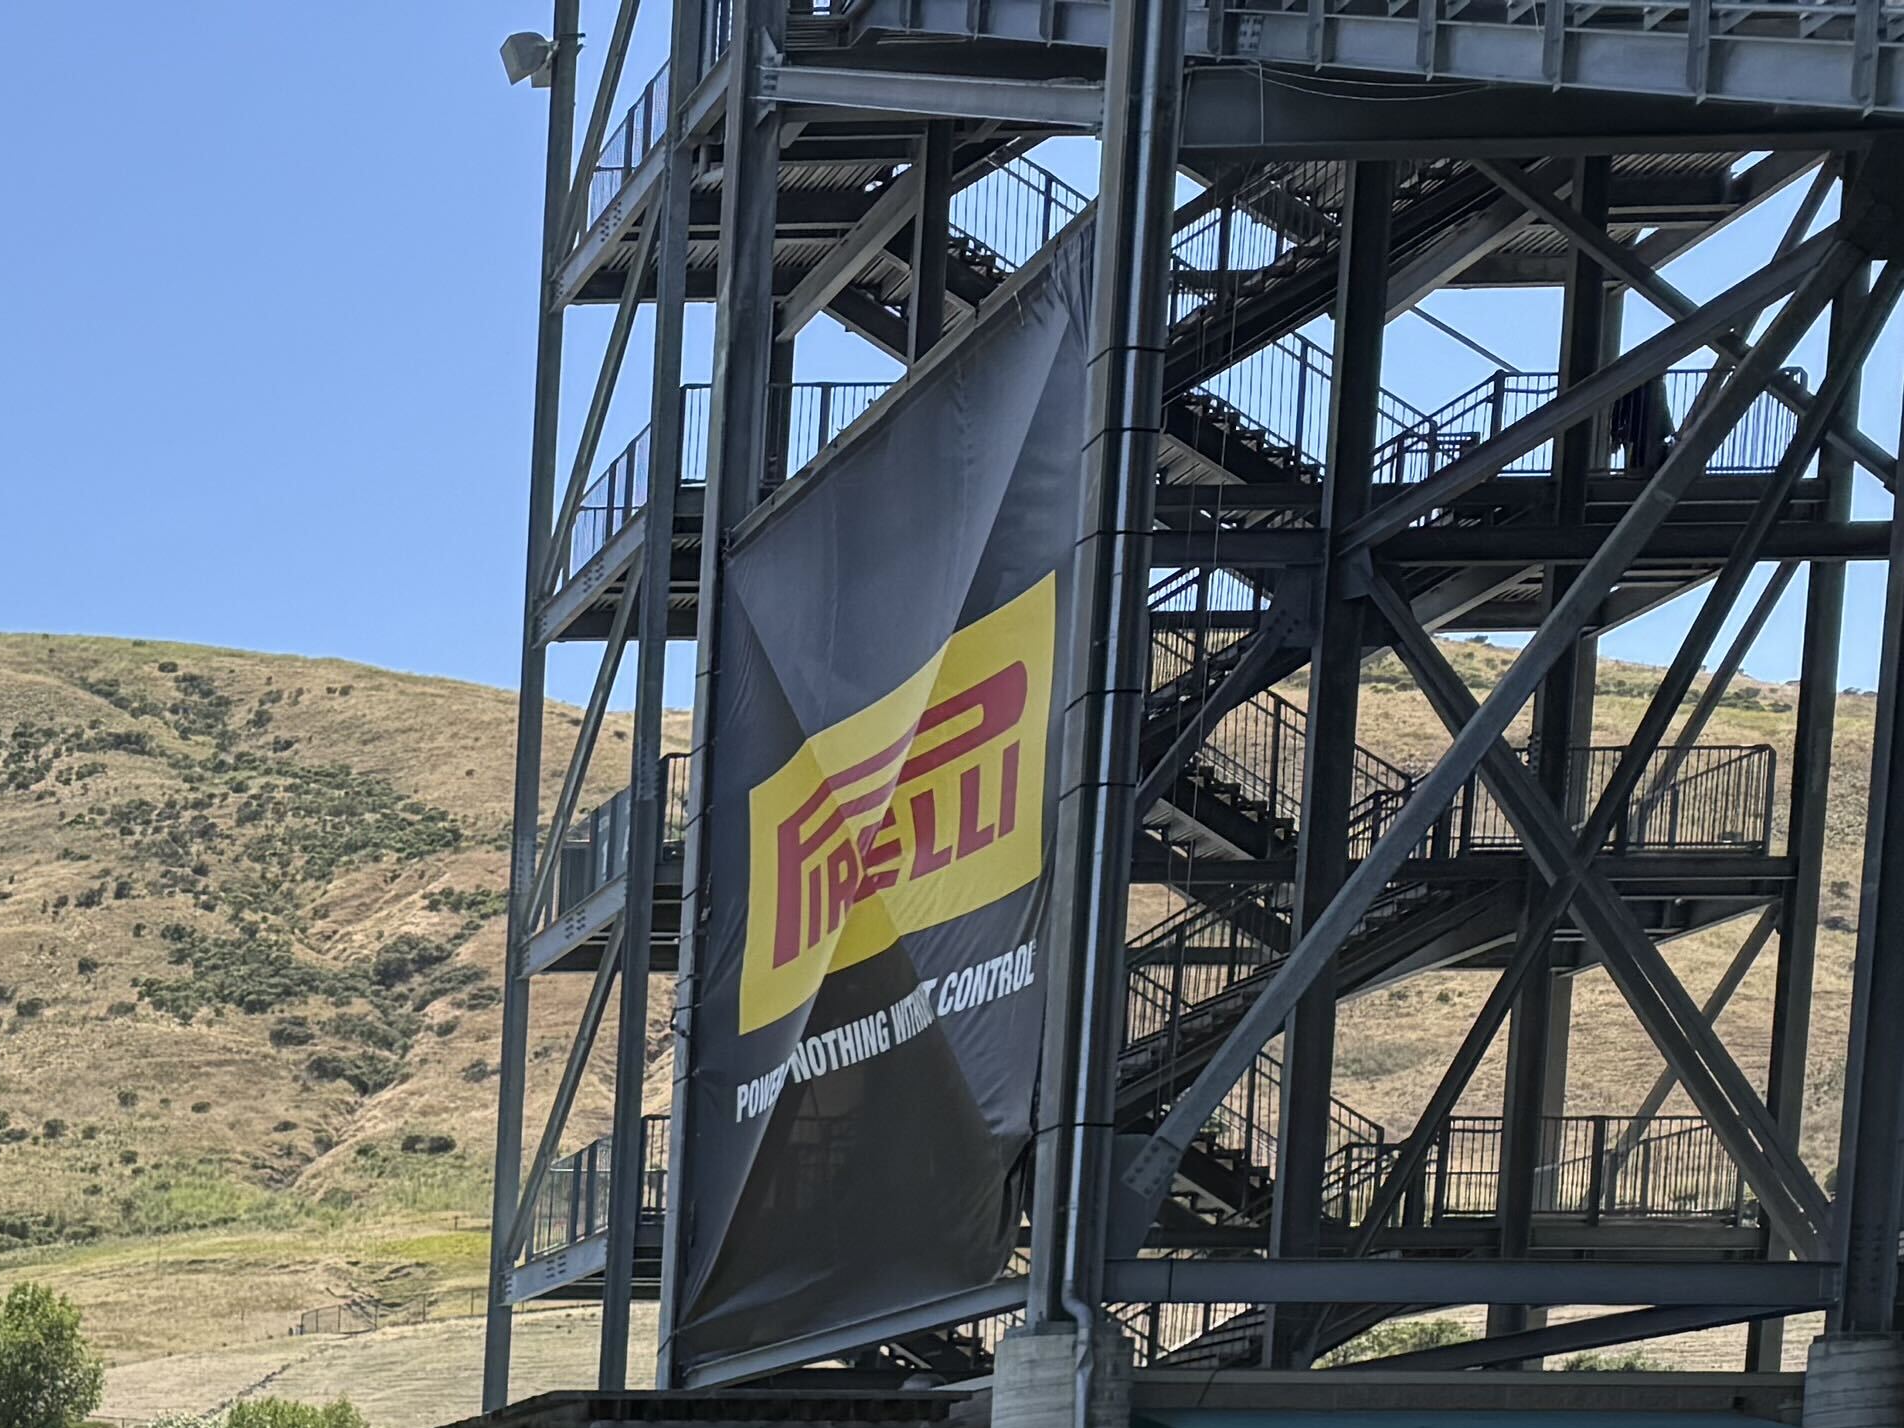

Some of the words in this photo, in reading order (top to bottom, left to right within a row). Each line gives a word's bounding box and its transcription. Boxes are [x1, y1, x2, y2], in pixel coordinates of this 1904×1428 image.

[773, 660, 1028, 970] PIRELLI
[791, 1009, 891, 1084] NOTHING
[937, 941, 1035, 1017] CONTROL
